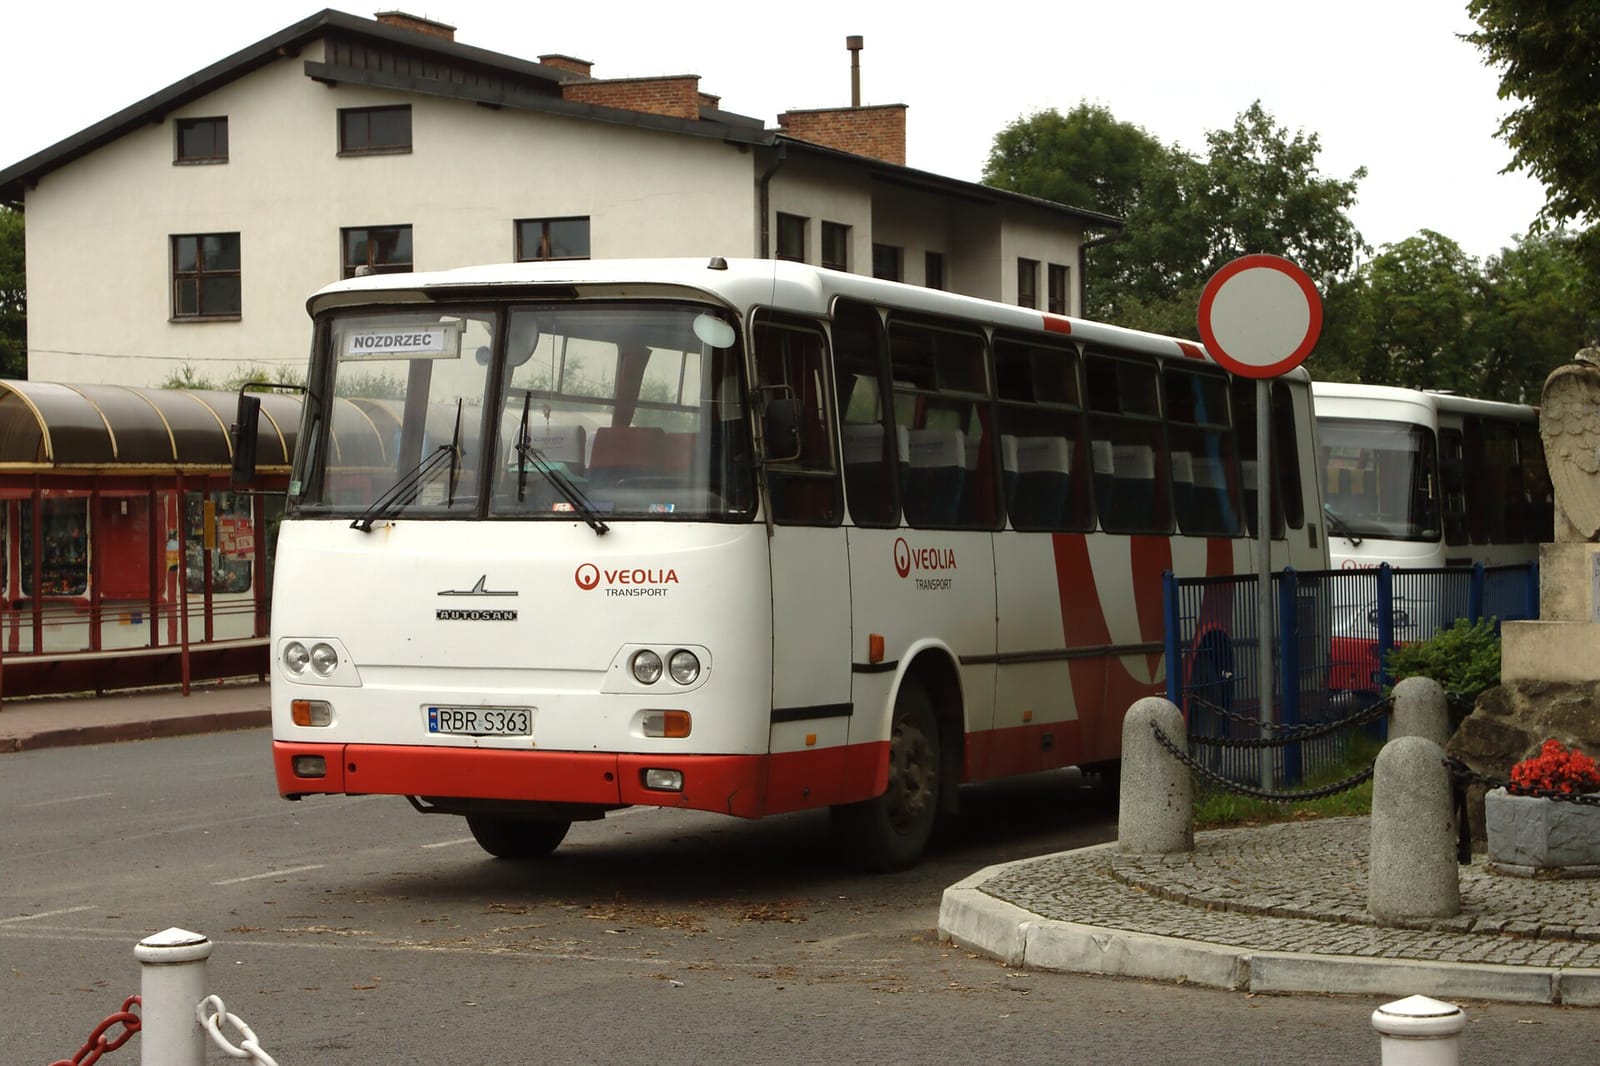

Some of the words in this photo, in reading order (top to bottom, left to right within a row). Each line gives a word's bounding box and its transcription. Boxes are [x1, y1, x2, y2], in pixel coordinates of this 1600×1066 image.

[354, 334, 432, 348] NOZDRZEC
[912, 548, 957, 570] VEOLIA
[604, 569, 679, 584] VEOLIA
[916, 579, 952, 590] TRANSPORT
[605, 588, 668, 596] TRANSPORT
[438, 609, 515, 621] AUTOSAN
[440, 711, 477, 731] RBR
[484, 712, 528, 731] S363
